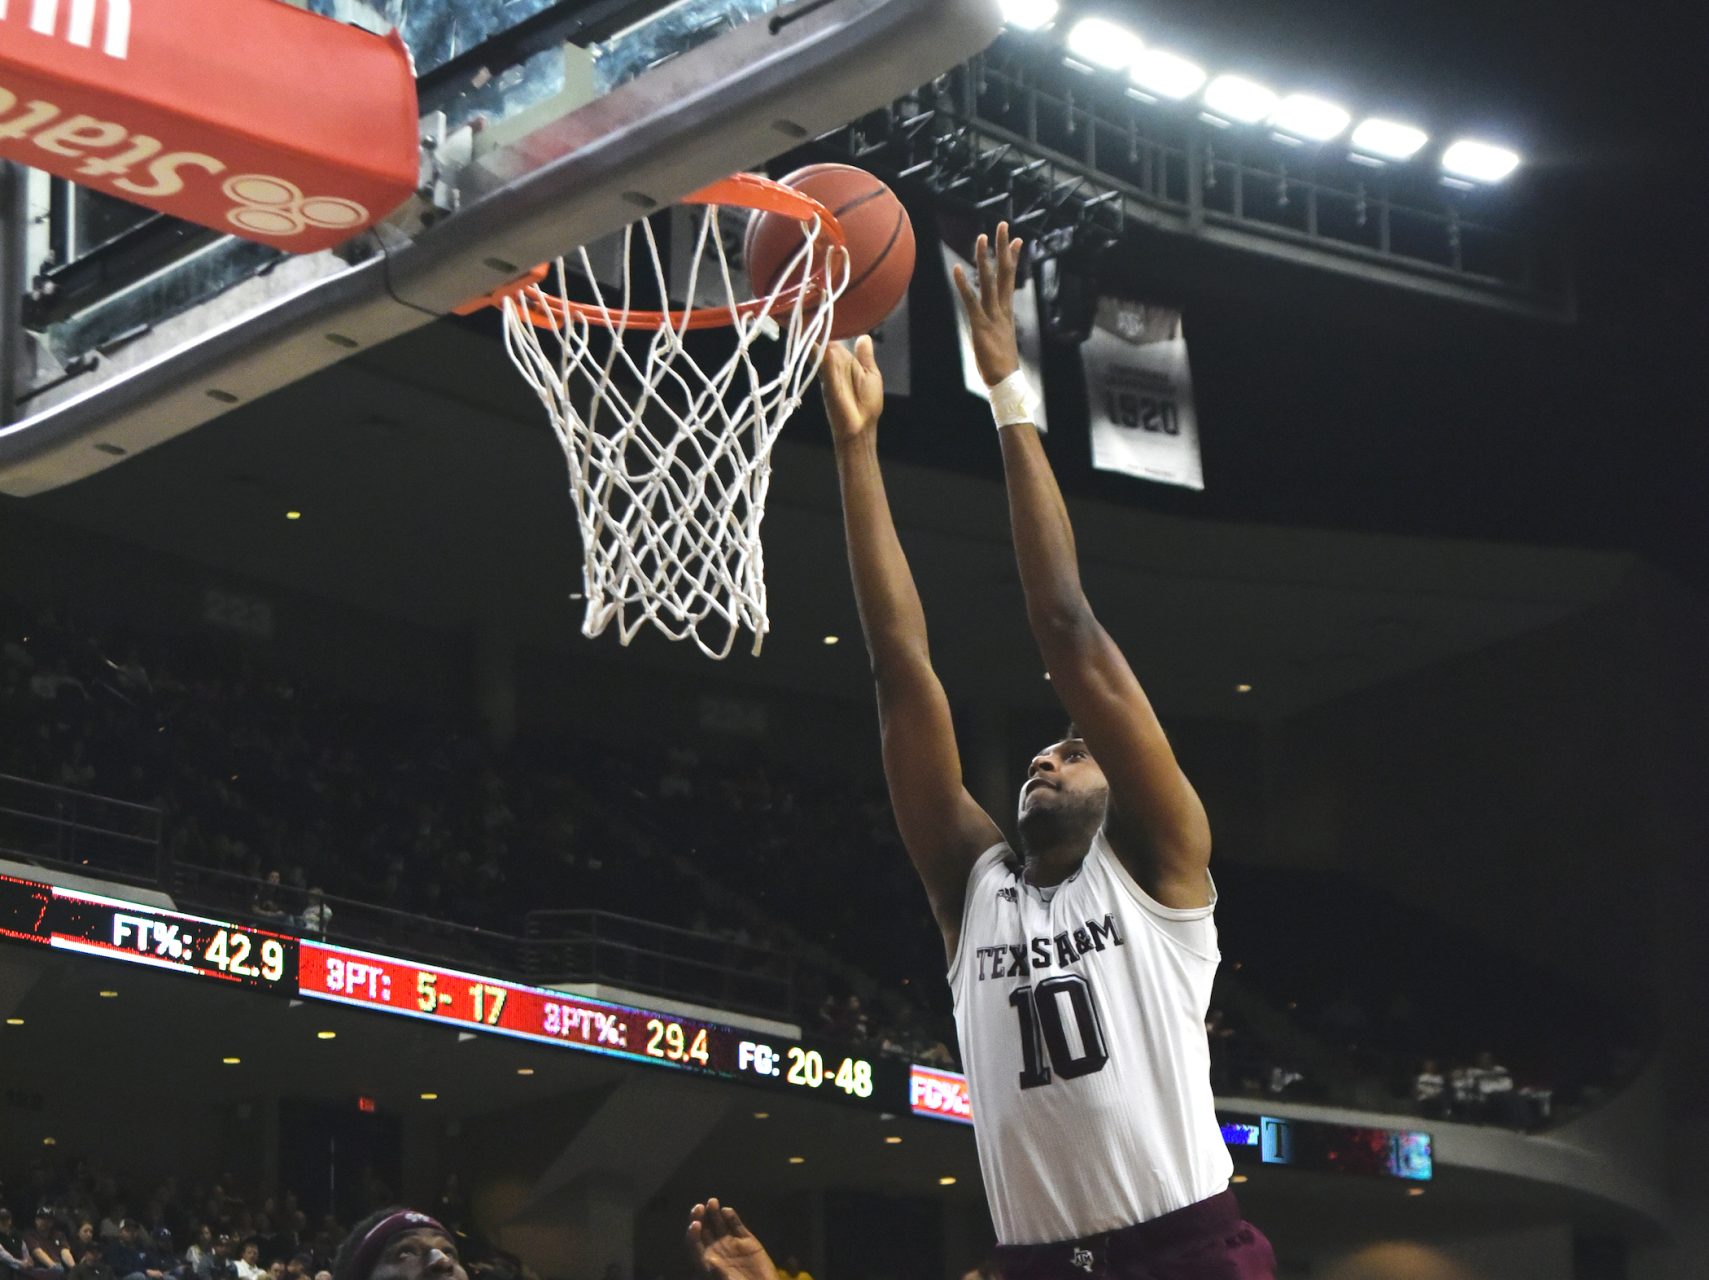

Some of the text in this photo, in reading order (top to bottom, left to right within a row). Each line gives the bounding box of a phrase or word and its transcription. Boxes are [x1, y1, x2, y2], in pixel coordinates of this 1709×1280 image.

[113, 912, 283, 981] FT%: 42.9
[326, 957, 391, 1001] 3PT:
[543, 1002, 709, 1066] 3PT%: 29.4
[1009, 974, 1109, 1090] 10
[738, 1041, 873, 1098] FG: 20-48
